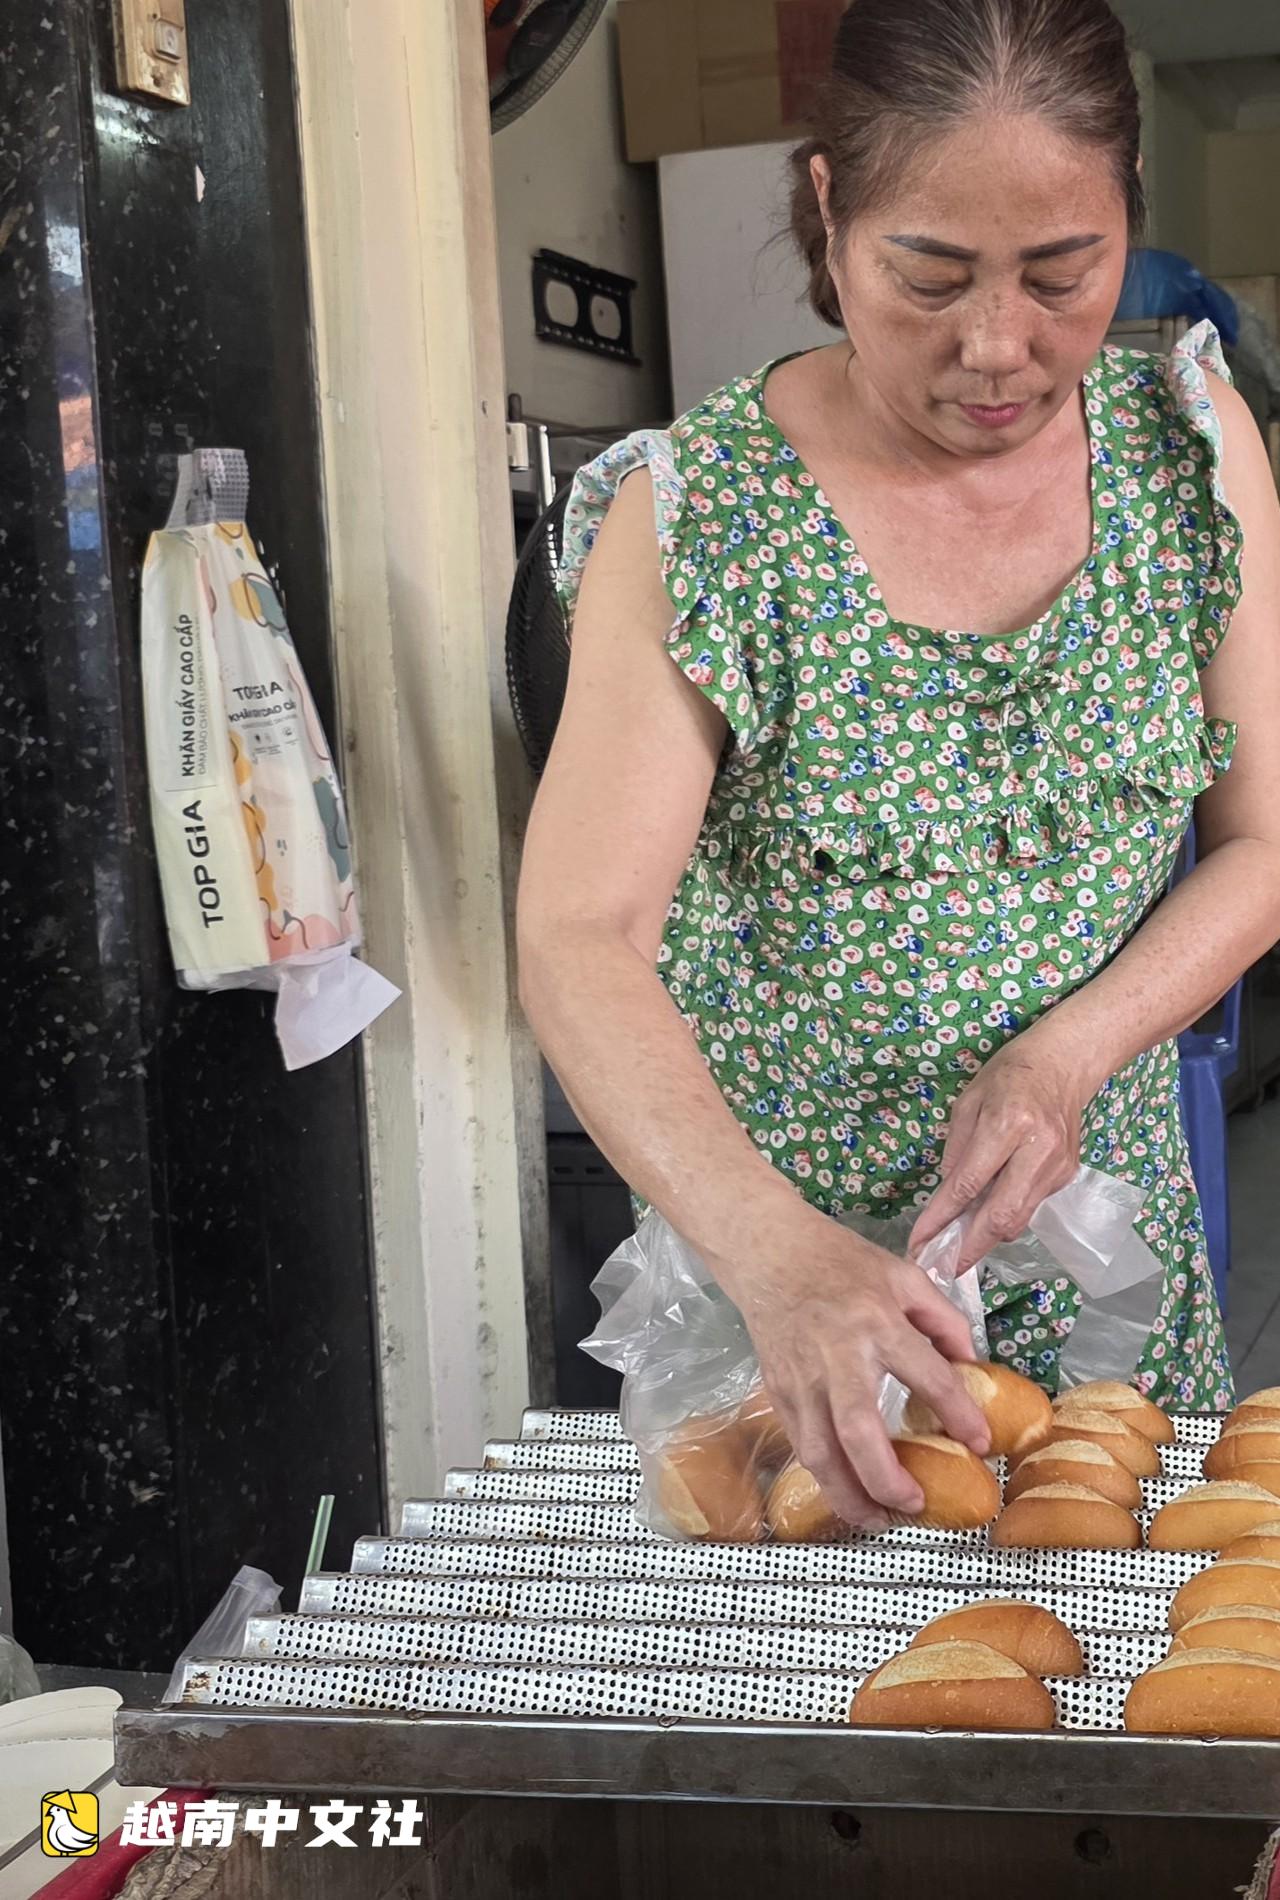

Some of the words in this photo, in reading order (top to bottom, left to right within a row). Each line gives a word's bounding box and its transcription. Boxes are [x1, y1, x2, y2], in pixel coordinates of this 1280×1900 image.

[173, 614, 194, 648] CẤP
[180, 651, 195, 686] CAO
[175, 689, 196, 727] GIẤY
[179, 730, 196, 777] KHĂN
[182, 799, 210, 858] GIA
[193, 864, 224, 929] TOP
